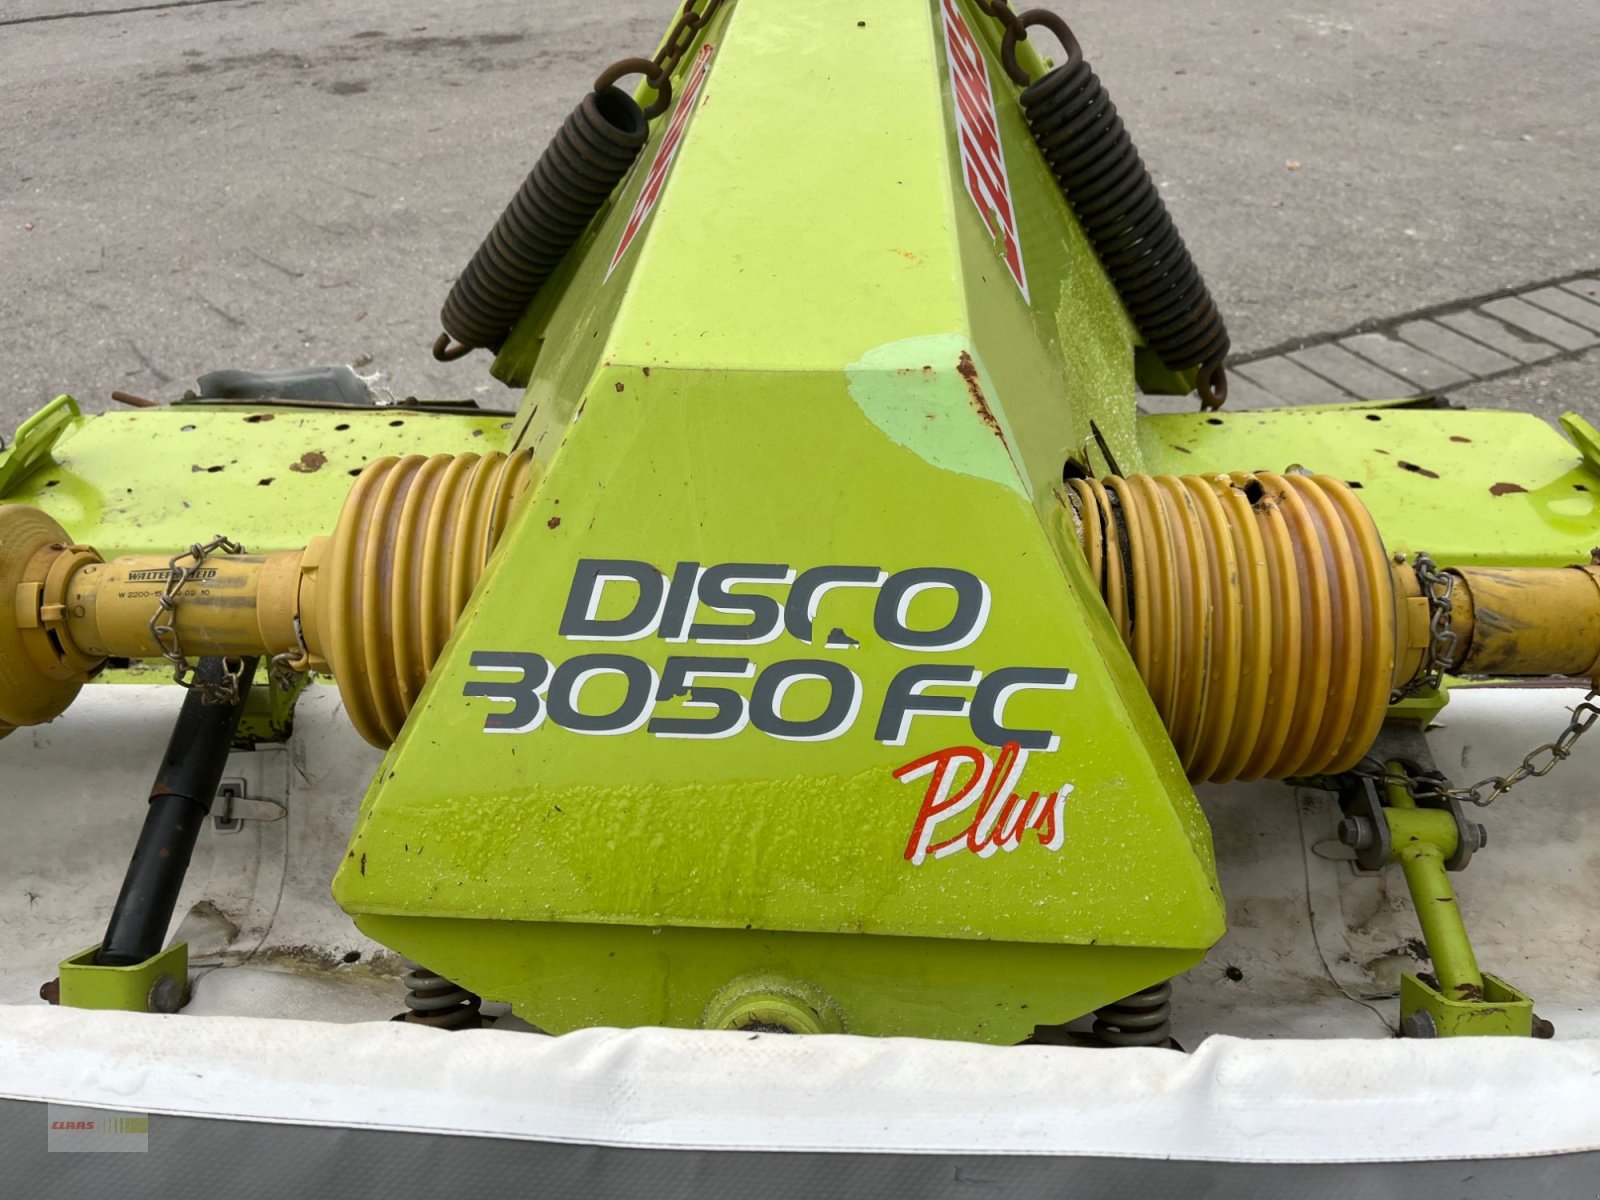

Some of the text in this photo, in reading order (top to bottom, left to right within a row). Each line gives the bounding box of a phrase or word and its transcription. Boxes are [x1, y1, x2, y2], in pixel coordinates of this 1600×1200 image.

[128, 569, 217, 581] WALTEHEID
[558, 558, 991, 652] DISCO
[463, 650, 1077, 752] 3050 FC
[893, 741, 1074, 866] Plus
